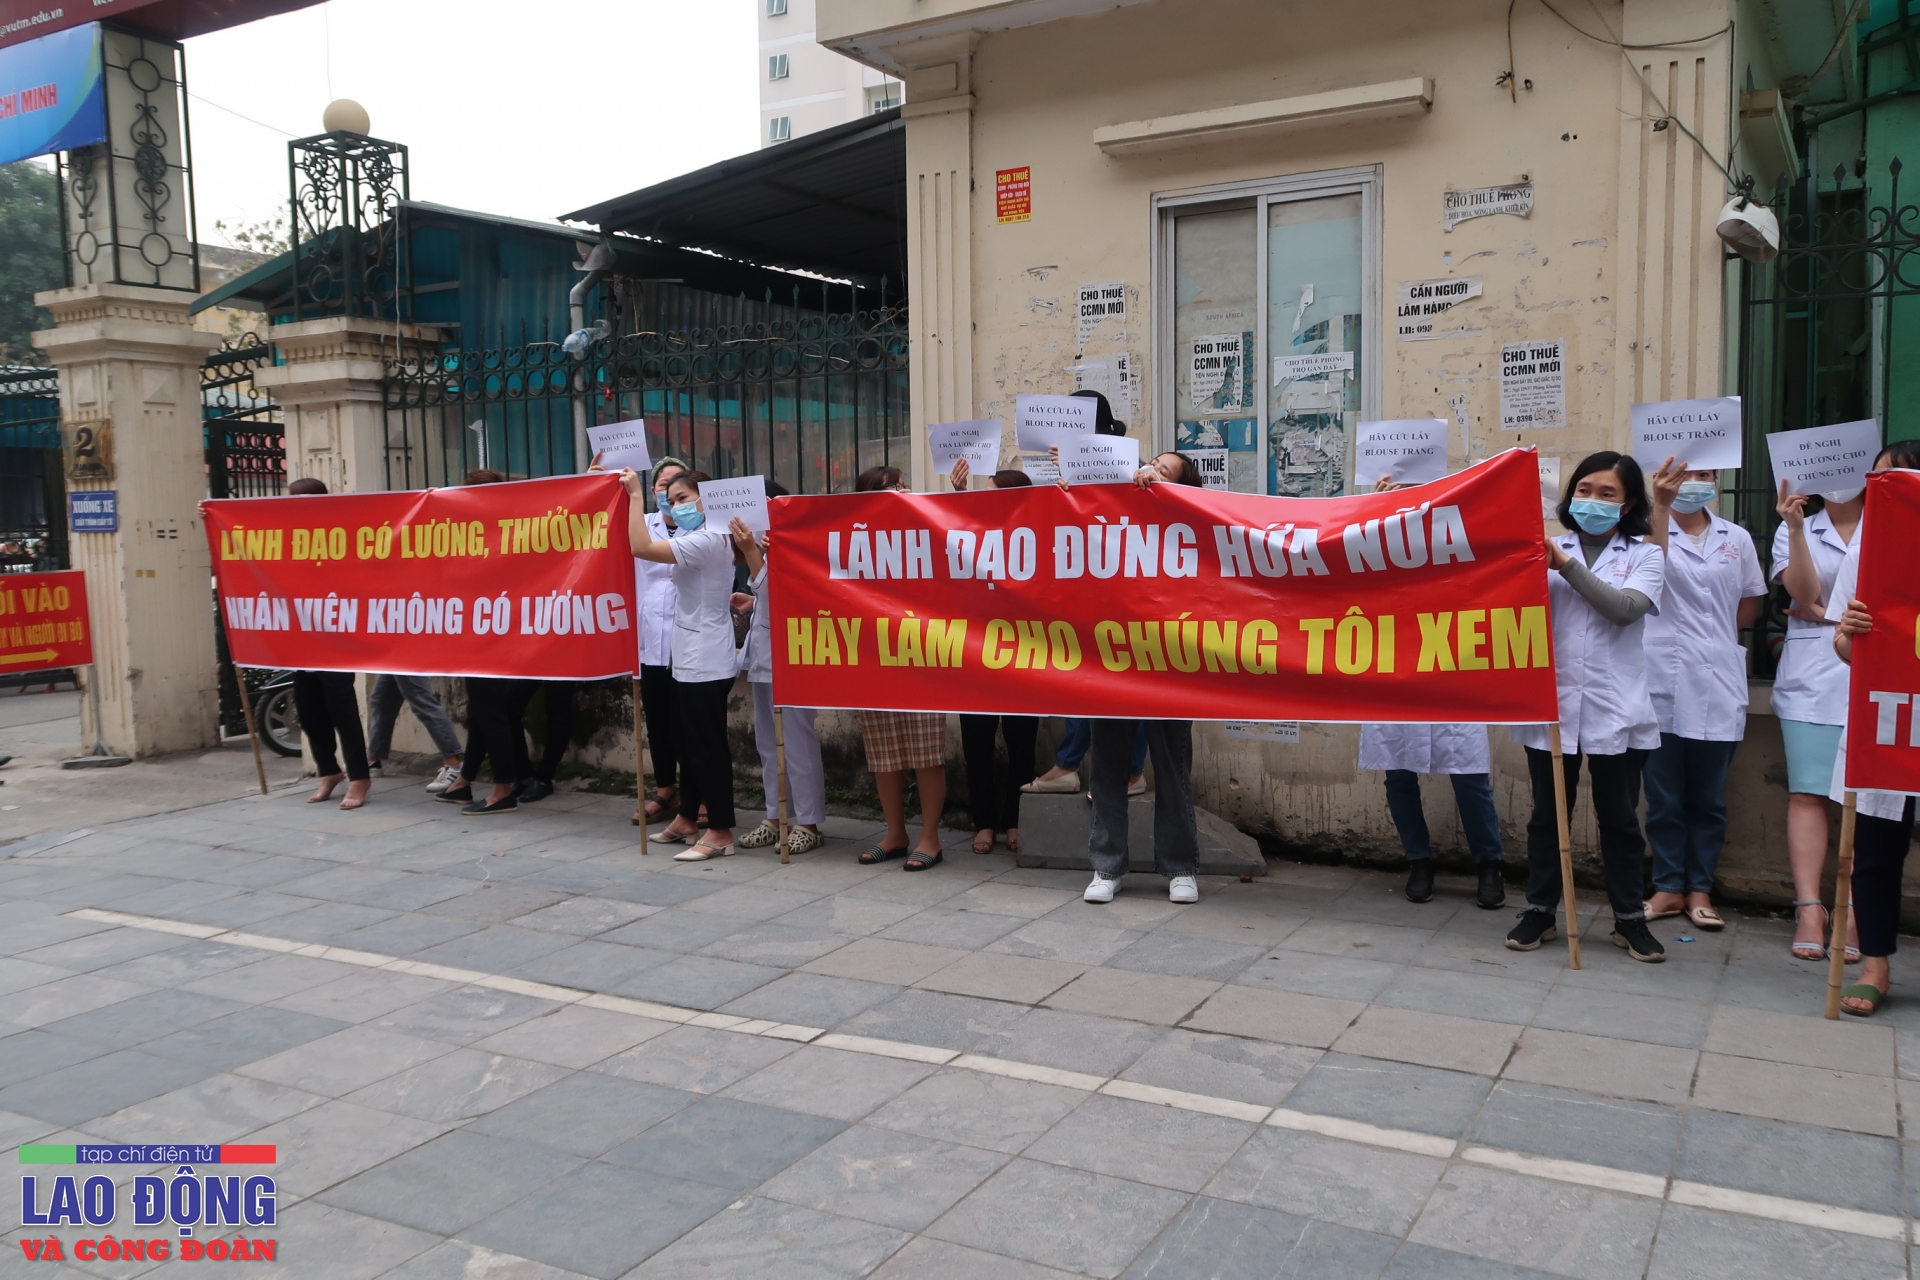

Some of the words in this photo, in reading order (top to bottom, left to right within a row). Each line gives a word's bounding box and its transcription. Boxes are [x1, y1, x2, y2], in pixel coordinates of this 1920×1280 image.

[20, 82, 58, 113] MINH
[998, 173, 1011, 184] CHO
[1013, 169, 1028, 181] THUÊ
[1446, 195, 1467, 209] CHO
[1469, 188, 1495, 206] THUÊ
[1081, 290, 1099, 301] CHO
[1101, 286, 1123, 299] THUÊ
[1435, 280, 1468, 297] NGƯỜI
[1081, 303, 1105, 316] CCMN
[1107, 299, 1124, 314] MỚI
[1398, 303, 1420, 317] LÀM
[1194, 343, 1213, 354] CHO
[1216, 339, 1239, 352] THUÊ
[1503, 350, 1526, 363] CHO
[1530, 344, 1559, 360] THUÊ
[1194, 357, 1220, 370] CCMN
[1301, 357, 1319, 365] THUÊ
[1503, 364, 1535, 377] CCMN
[1539, 359, 1560, 373] MỚI
[1028, 404, 1046, 413] HÃY
[1047, 405, 1064, 414] CỨU
[1025, 419, 1055, 428] BLOUSE
[1057, 420, 1086, 430] TRẮNG
[1504, 416, 1515, 424] LH:
[1647, 415, 1669, 425] HÃY
[1672, 413, 1695, 423] CỨU
[1698, 411, 1721, 422] LẤY
[74, 427, 95, 458] 2
[1369, 432, 1387, 441] HÃY
[1389, 431, 1409, 441] CỨU
[1643, 431, 1685, 442] BLOUSE
[1687, 428, 1726, 439] TRẮNG
[1092, 446, 1113, 454] NGHỊ
[1365, 448, 1399, 456] BLOUSE
[1402, 446, 1434, 455] TRẮNG
[1814, 438, 1841, 449] NGHỊ
[971, 452, 982, 460] TÔI
[1082, 459, 1110, 468] LƯƠNG
[1201, 455, 1225, 472] THUÊ
[1782, 457, 1801, 468] TRẢ
[1803, 454, 1841, 466] LƯƠNG
[1842, 449, 1866, 460] CHO
[1077, 472, 1104, 481] CHÚNG
[1105, 471, 1119, 480] TÔI
[1209, 475, 1226, 485] 100%
[1797, 470, 1834, 481] CHÚNG
[1836, 465, 1855, 475] TÔI
[720, 489, 735, 498] CỨU
[72, 495, 101, 514] XUỐNG
[102, 500, 114, 513] XE
[708, 503, 730, 511] BLOUSE
[221, 525, 282, 560] LÃNH
[291, 526, 347, 566] ĐẠO
[356, 521, 392, 560] CÓ
[401, 518, 489, 559] LƯƠNG,
[498, 506, 609, 555] THƯỞNG
[828, 522, 934, 580] LÃNH
[945, 526, 1037, 590] ĐẠO
[1052, 515, 1199, 578] ĐỪNG
[1212, 523, 1331, 578] HỨA
[1343, 500, 1476, 574] NỮA
[21, 581, 70, 613] VÀO
[225, 591, 290, 631] NHÂN
[293, 592, 358, 633] VIÊN
[367, 591, 463, 634] KHÔNG
[472, 590, 511, 635] CÓ
[520, 589, 629, 635] LƯƠNG
[9, 621, 23, 648] VÀ
[24, 618, 55, 646] NGƯỜI
[57, 622, 67, 643] ĐI
[69, 616, 83, 646] BỘ
[786, 609, 862, 666] HÃY
[876, 610, 968, 668] LÀM
[981, 618, 1082, 671] CHO
[1094, 611, 1278, 675] CHÚNG
[1299, 605, 1395, 676] TÔI
[1416, 605, 1550, 673] XEM
